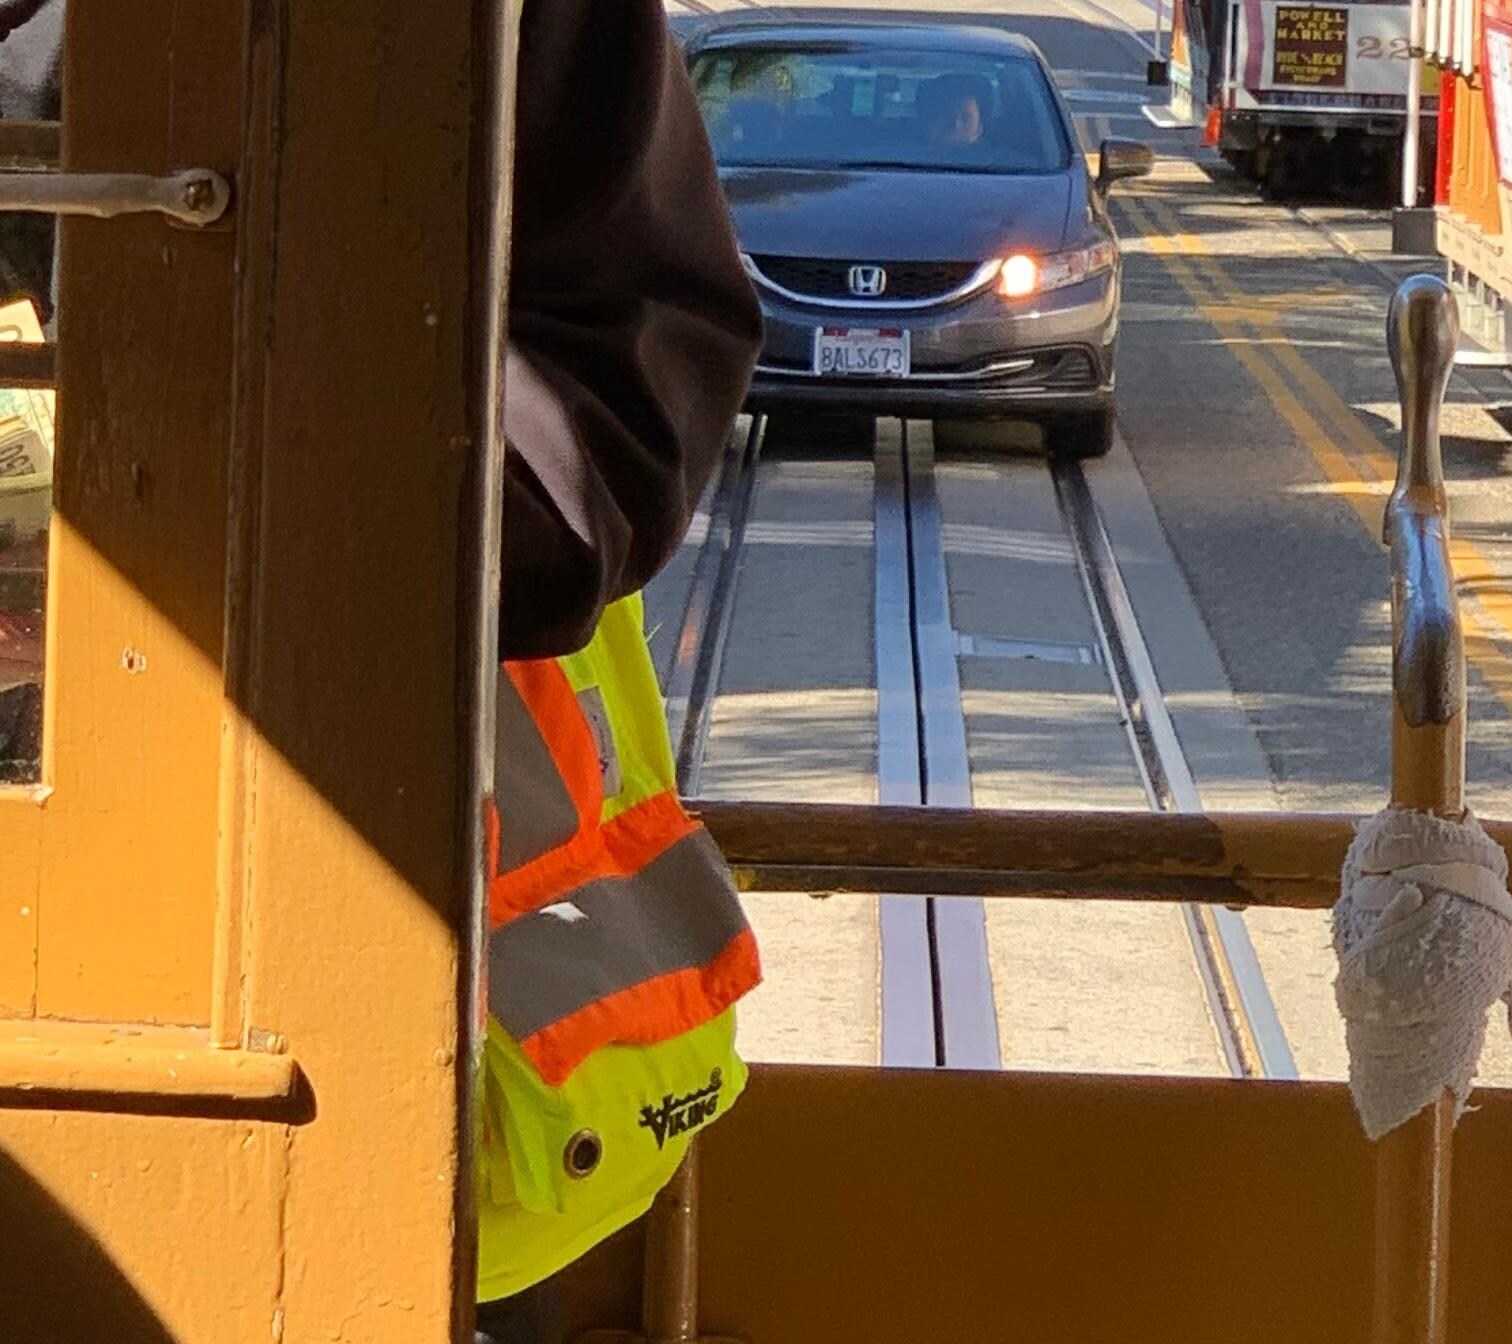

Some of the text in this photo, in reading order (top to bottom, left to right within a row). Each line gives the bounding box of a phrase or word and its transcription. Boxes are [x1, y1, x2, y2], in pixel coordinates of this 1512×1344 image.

[1279, 10, 1346, 23] POWELL
[1296, 22, 1329, 30] AND
[1277, 28, 1346, 41] MARKET
[638, 1076, 721, 1150] VIKING
